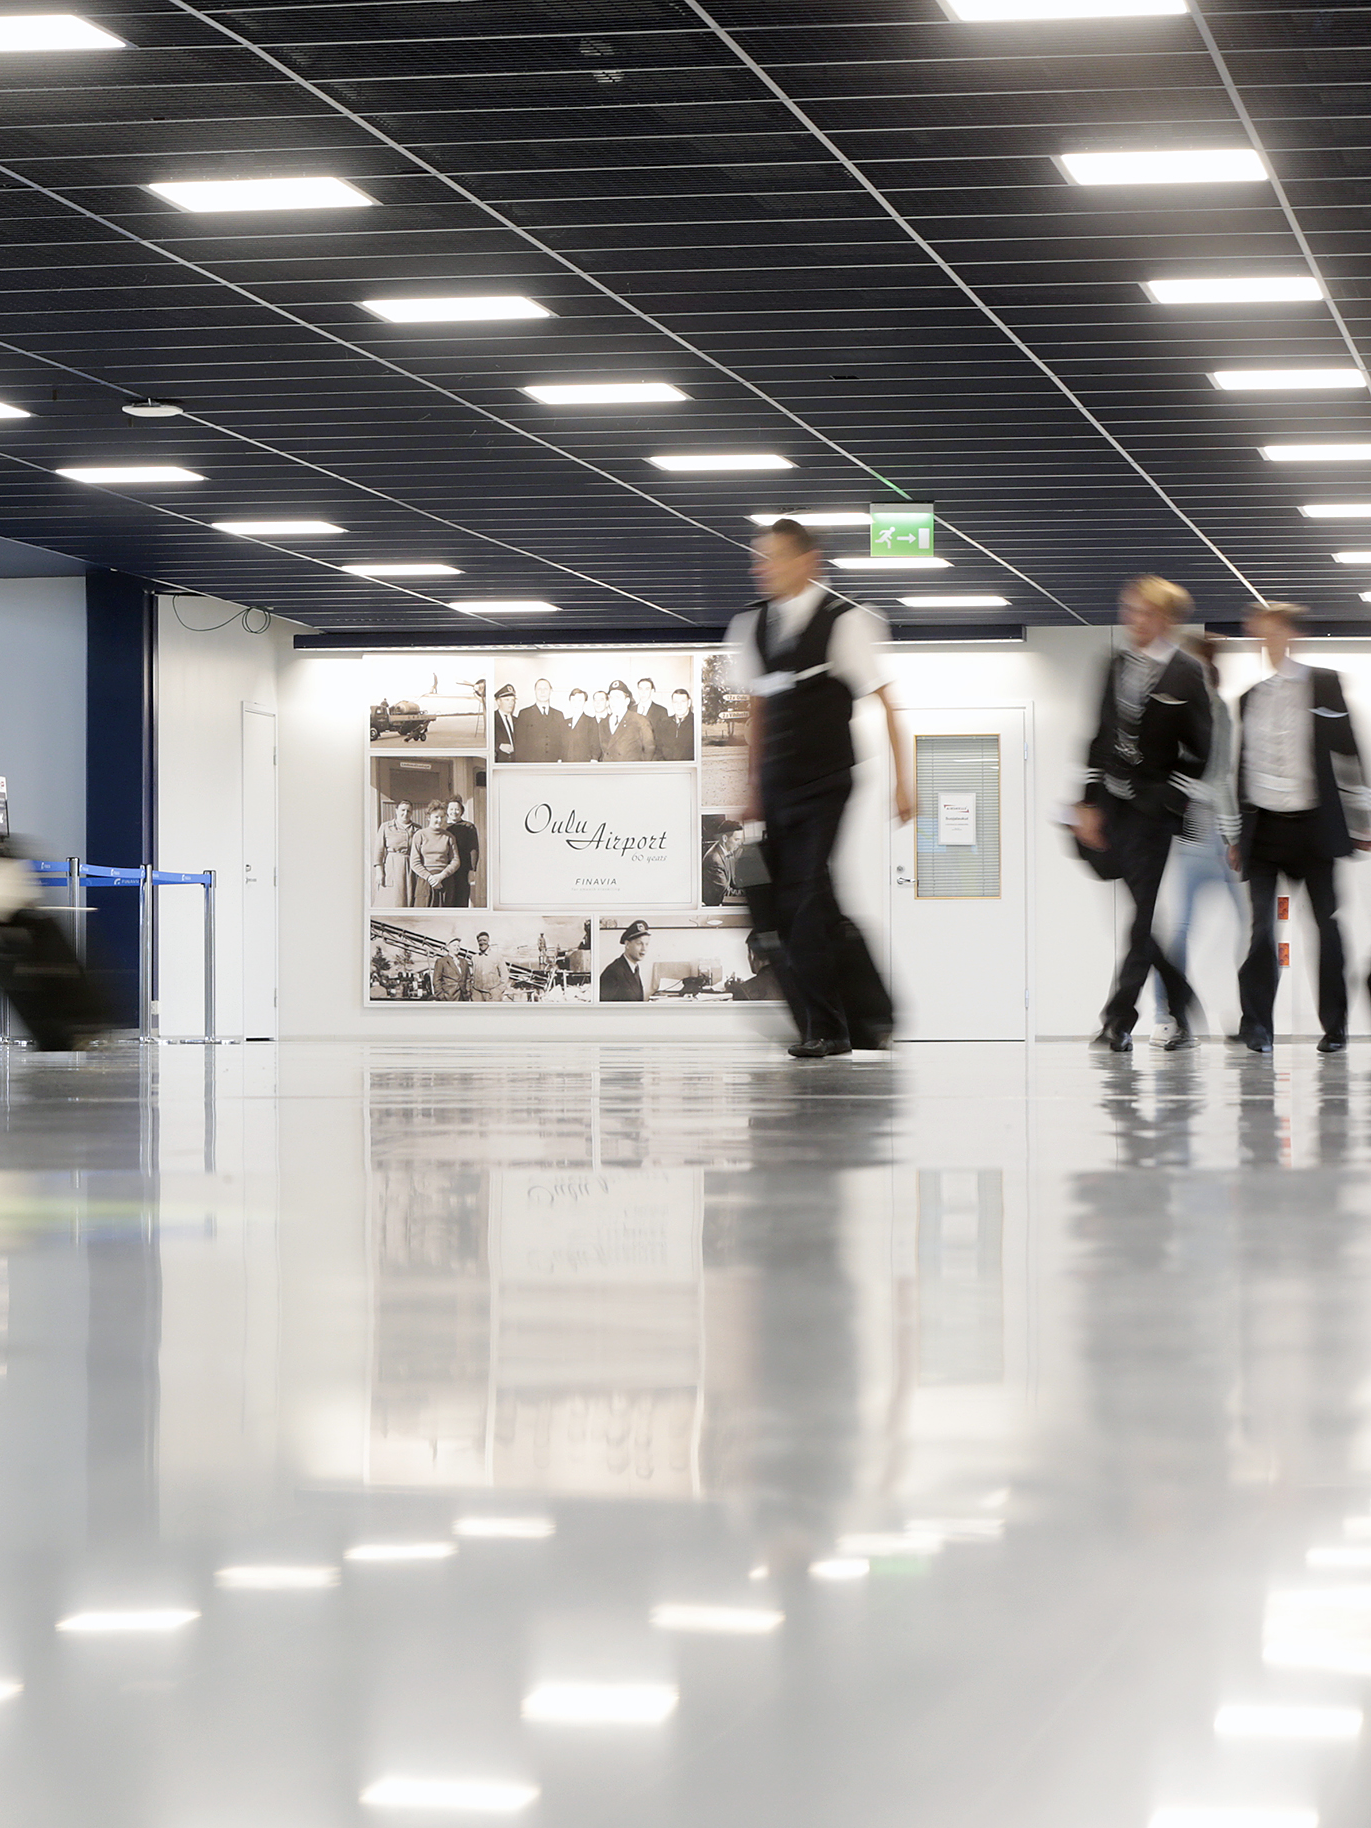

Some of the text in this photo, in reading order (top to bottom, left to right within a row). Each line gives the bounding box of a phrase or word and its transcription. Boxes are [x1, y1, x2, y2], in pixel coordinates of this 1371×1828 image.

[524, 803, 589, 834] Oulu
[565, 822, 668, 857] Airport
[631, 852, 668, 863] 60 years
[575, 878, 617, 886] FINAVIA
